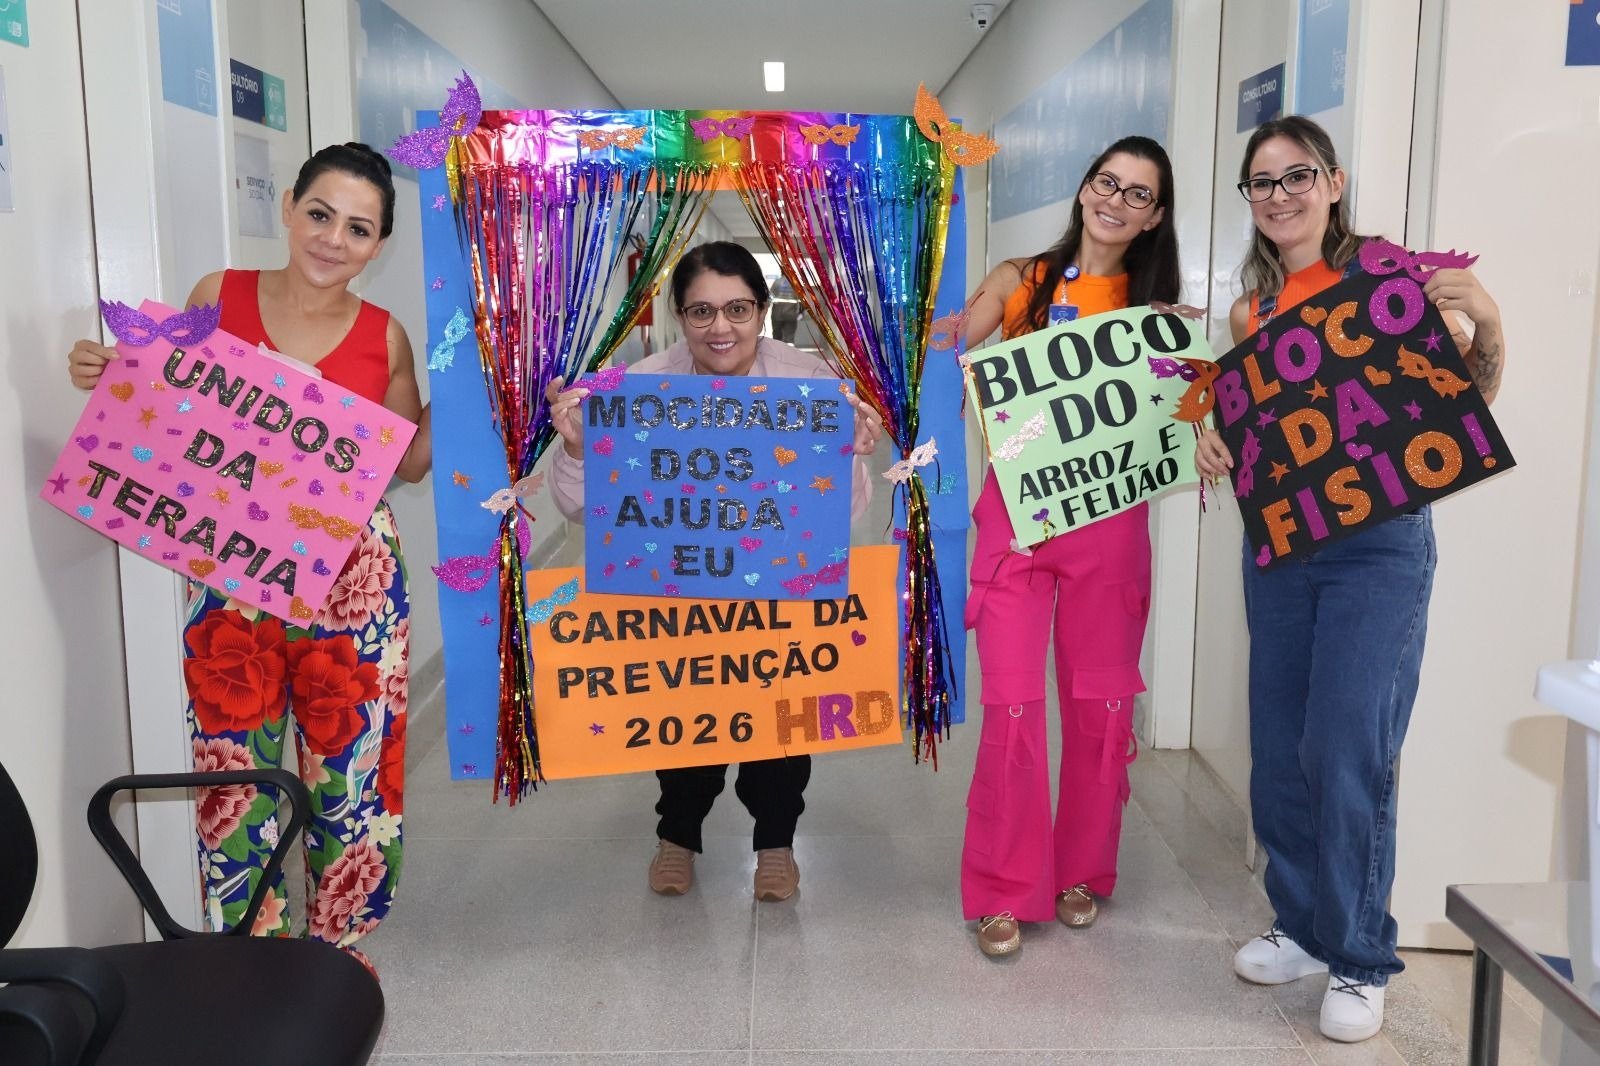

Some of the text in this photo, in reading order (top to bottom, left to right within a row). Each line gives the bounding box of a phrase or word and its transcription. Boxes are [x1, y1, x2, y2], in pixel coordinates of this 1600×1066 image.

[1243, 79, 1277, 104] CONSULTÓRIO
[970, 313, 1191, 410] BLOCO
[1213, 277, 1425, 428] BLOCO
[162, 347, 361, 473] UNIDOS
[588, 394, 839, 433] MOCIDADE
[1048, 379, 1138, 444] DO
[1279, 378, 1391, 467] DA
[183, 428, 257, 491] DA
[650, 447, 754, 483] DOS
[1019, 423, 1181, 504] ARROZ E
[614, 495, 785, 531] AJUDA
[1059, 457, 1179, 528] FEIJÃO
[87, 460, 298, 597] TERAPIA
[673, 544, 735, 578] EU
[549, 593, 868, 645] CARNAVAL DA
[557, 641, 840, 698] PREVENÇÃO
[625, 690, 895, 749] 2026 HRD
